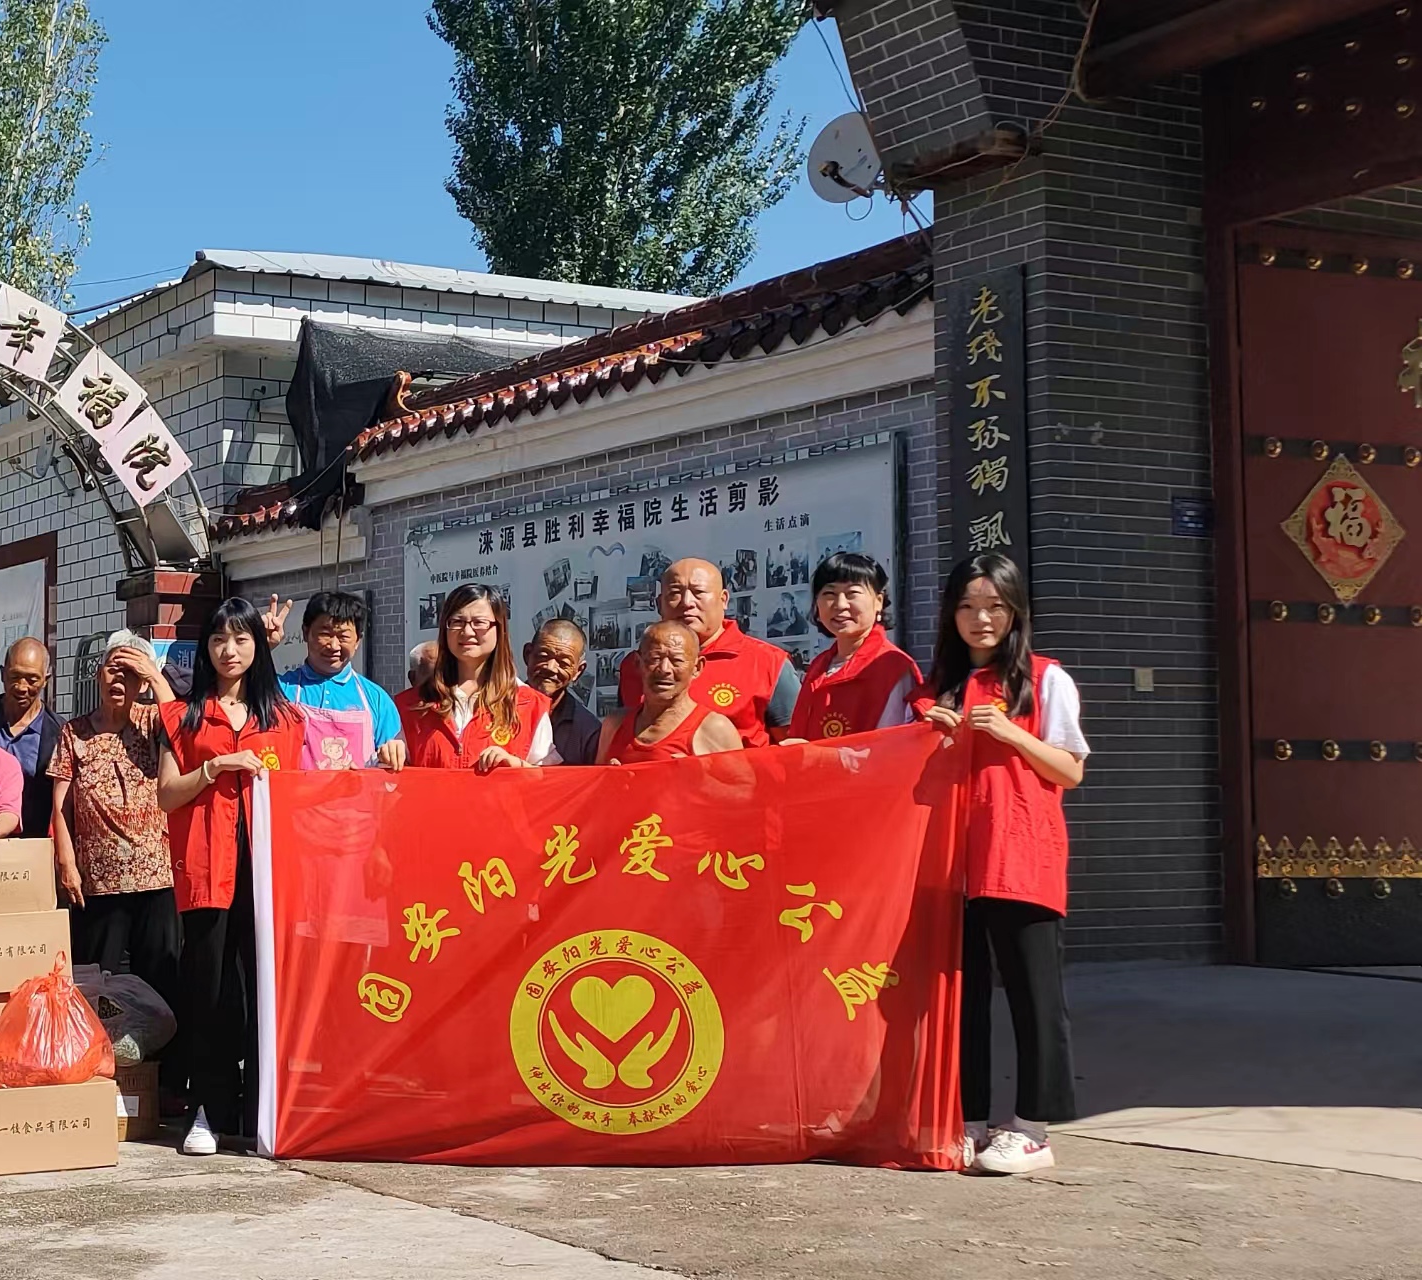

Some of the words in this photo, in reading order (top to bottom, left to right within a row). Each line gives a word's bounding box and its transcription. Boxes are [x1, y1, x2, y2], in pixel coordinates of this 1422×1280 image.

[478, 475, 780, 555] 涞源县胜利幸福院生活剪影
[764, 511, 810, 533] 生活点滴
[1325, 486, 1372, 548] 福
[358, 812, 900, 1024] 固安阳光爱心公益
[525, 935, 703, 1000] 固安阳光爱心公益
[628, 1066, 708, 1127] 奉献你的爱心
